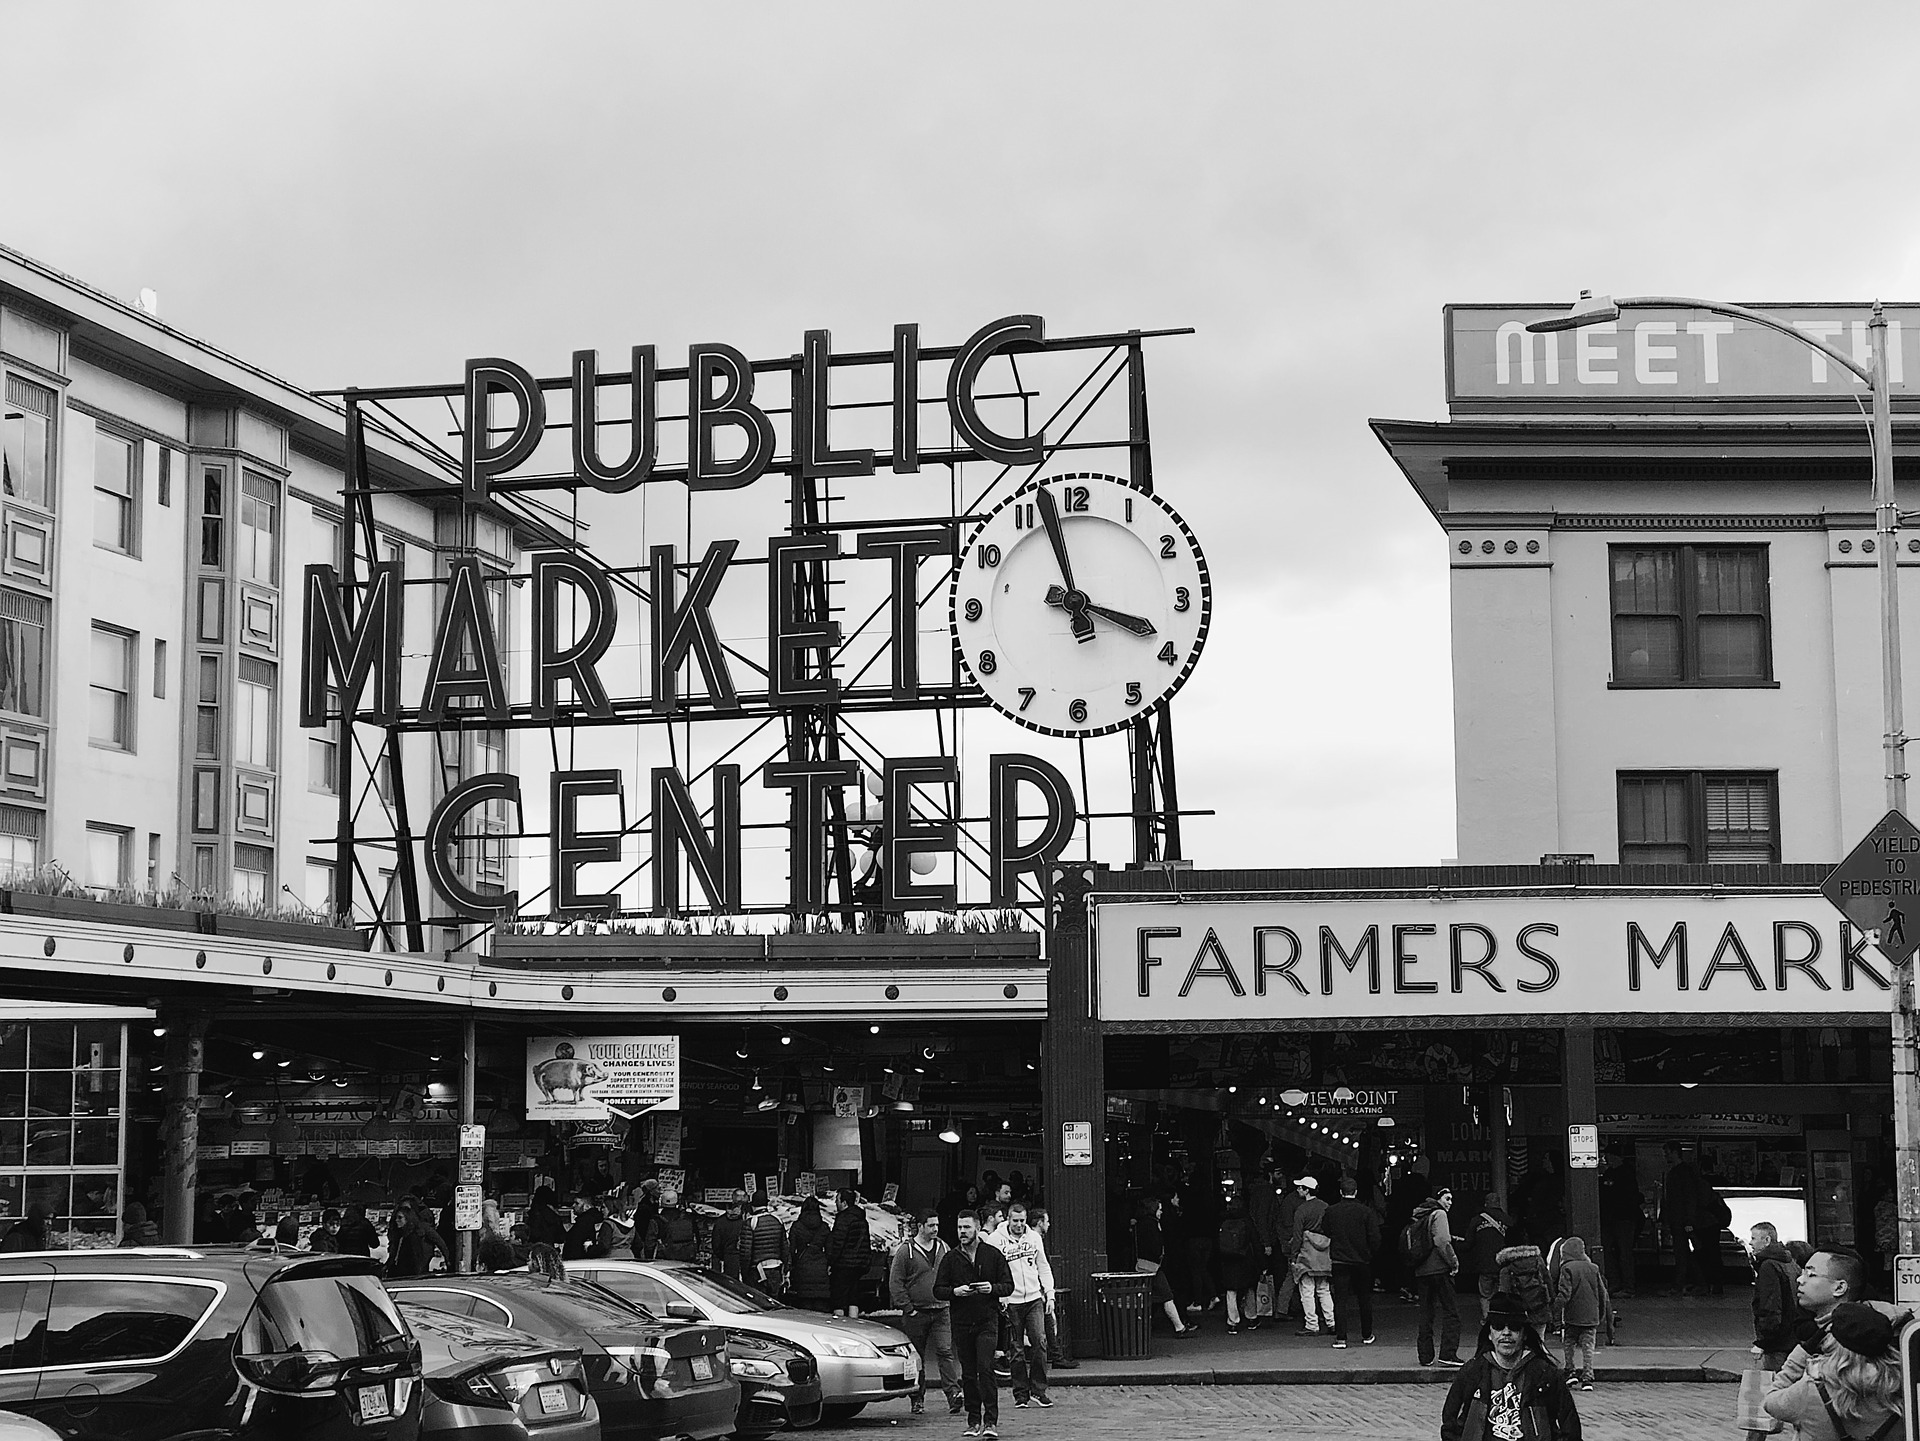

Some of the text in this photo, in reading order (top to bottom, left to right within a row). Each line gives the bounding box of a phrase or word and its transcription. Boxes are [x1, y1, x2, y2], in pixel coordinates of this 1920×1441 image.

[1495, 320, 1734, 384] MEET
[464, 315, 1045, 504] PUBLIC
[1064, 486, 1090, 512] 12
[1125, 498, 1132, 522] 1
[1015, 504, 1034, 530] 11
[978, 544, 1001, 569] 10
[1160, 535, 1176, 559] 2
[965, 598, 983, 622] 9
[1174, 587, 1190, 612] 3
[300, 528, 953, 728] MARKET
[979, 650, 997, 674] 8
[1157, 641, 1178, 666] 4
[1017, 687, 1036, 711] 7
[1124, 682, 1142, 706] 5
[1069, 698, 1088, 723] 6
[425, 753, 1076, 920] CENTER
[1870, 837, 1920, 853] YIELD
[1885, 859, 1907, 874] TO
[1840, 880, 1920, 896] PEDESTRI
[1137, 920, 1891, 998] FARMERS MARK
[588, 1043, 675, 1060] YOUR CHANGE
[1067, 1132, 1088, 1140] STOPS
[1573, 1135, 1594, 1143] STOPS
